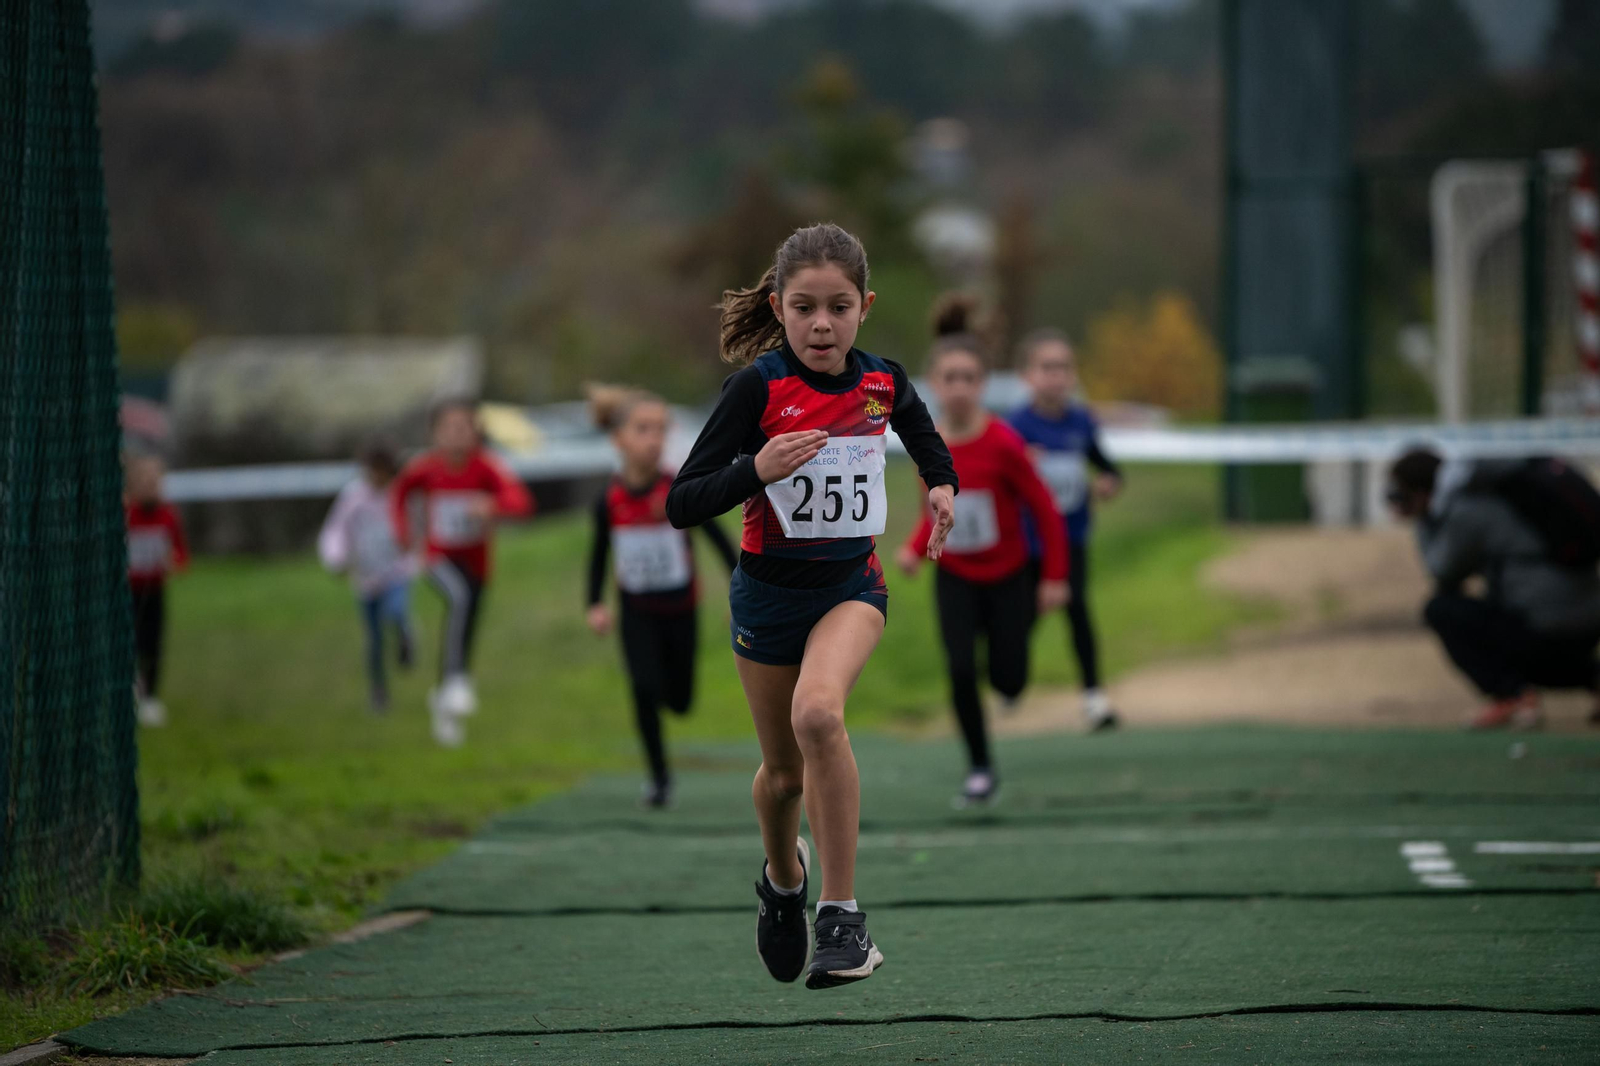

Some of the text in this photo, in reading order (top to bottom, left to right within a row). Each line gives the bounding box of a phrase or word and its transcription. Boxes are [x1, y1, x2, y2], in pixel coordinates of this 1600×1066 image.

[816, 447, 840, 456] PORTE
[807, 457, 838, 466] GALEGO
[791, 474, 869, 522] 255
